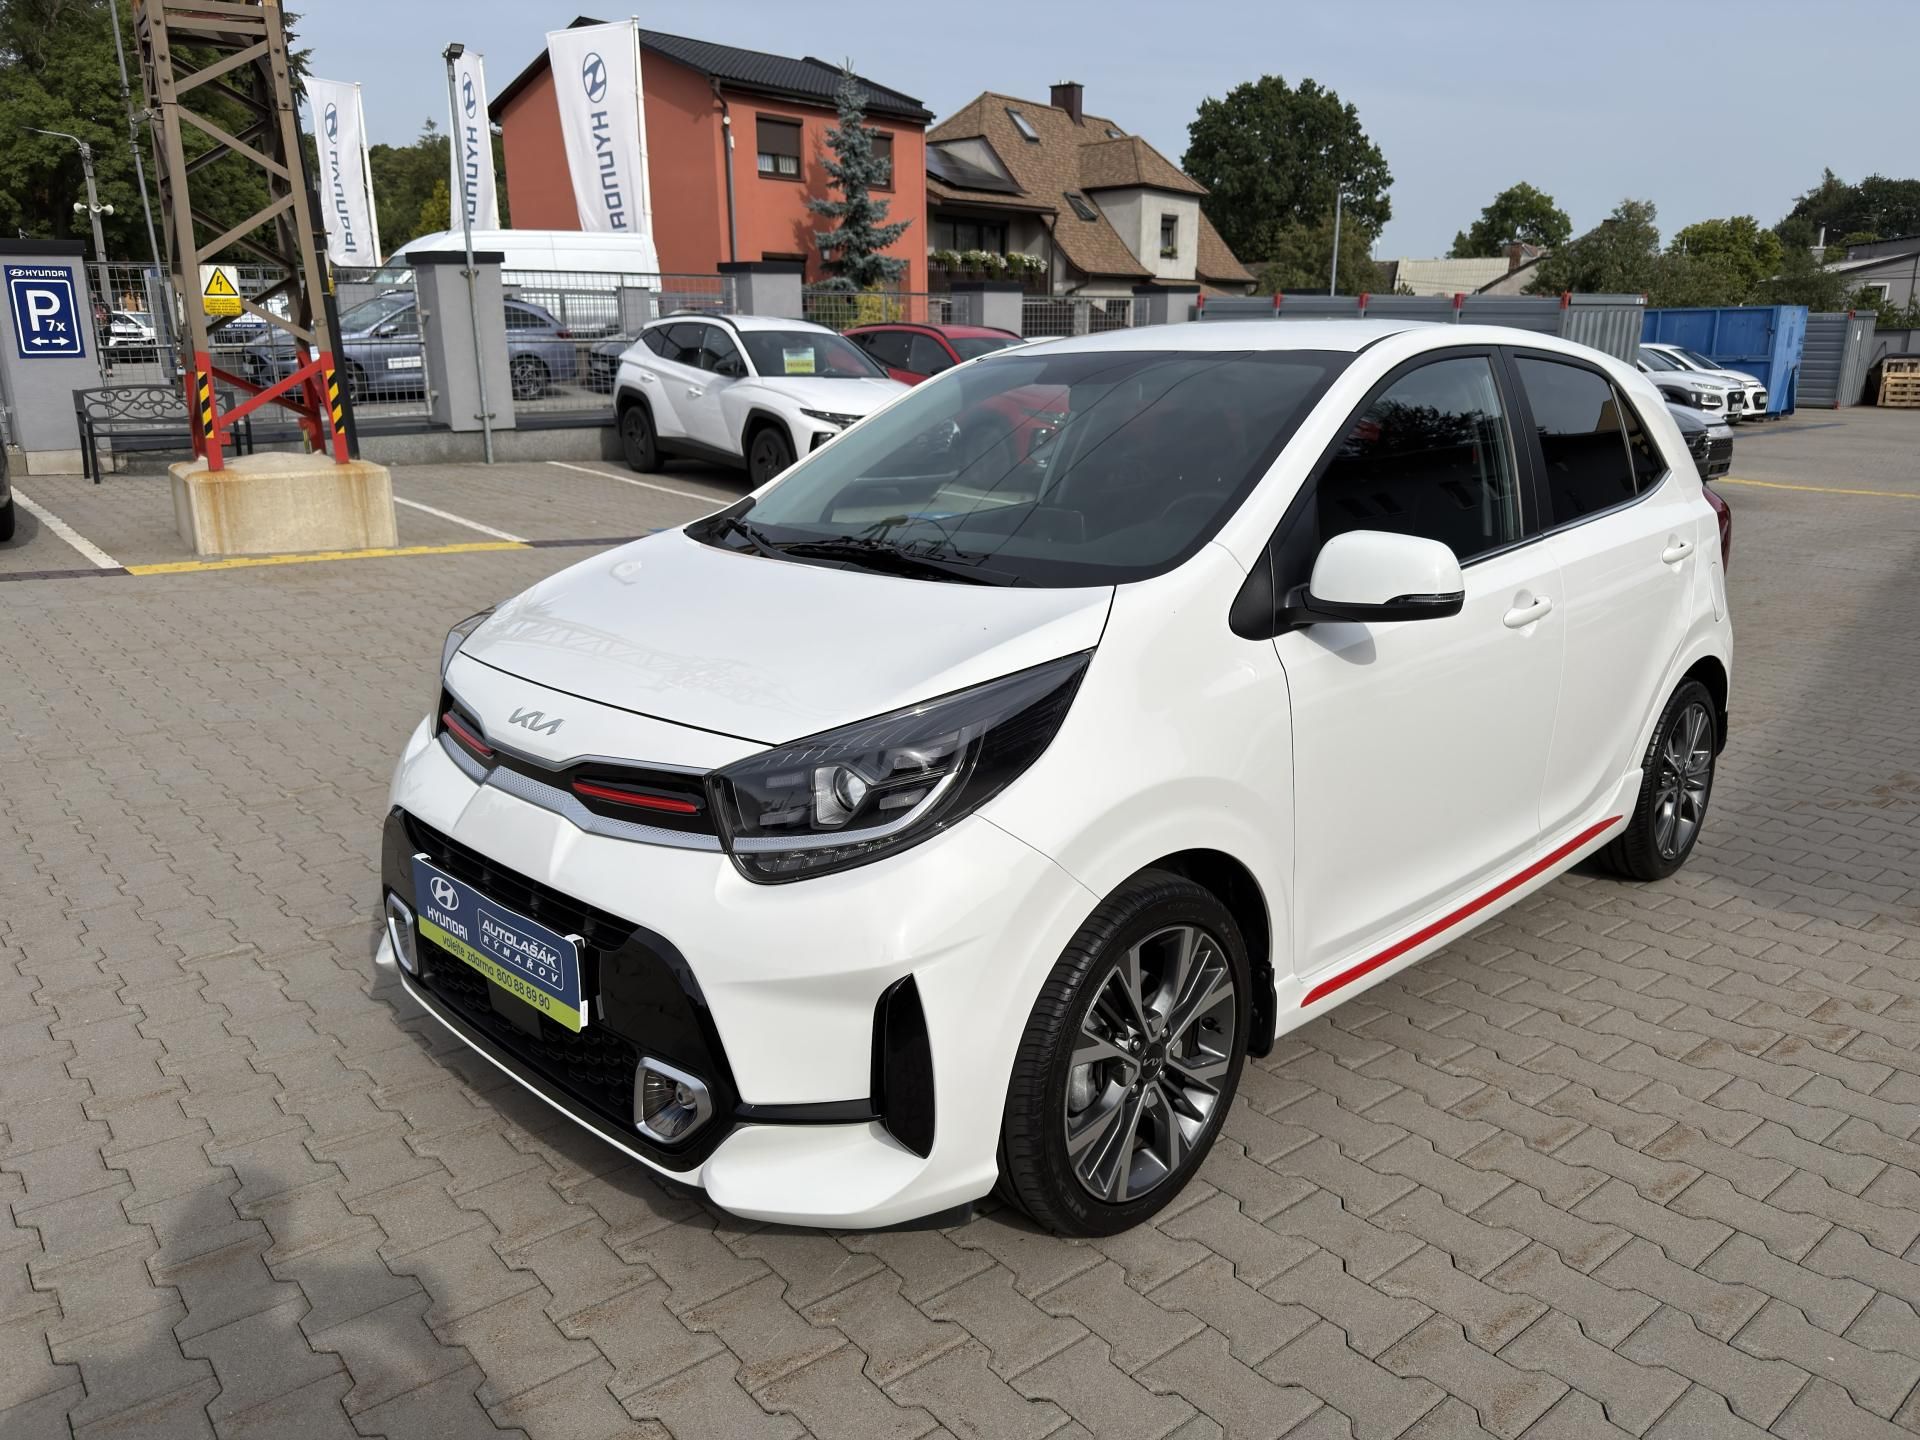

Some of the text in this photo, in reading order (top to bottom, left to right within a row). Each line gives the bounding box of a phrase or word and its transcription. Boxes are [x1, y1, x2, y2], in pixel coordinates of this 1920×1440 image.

[25, 269, 67, 277] HYUNDAI
[26, 290, 60, 331] P
[46, 319, 67, 331] 7x
[427, 905, 468, 941] HYUNDAI
[482, 919, 557, 969] AUTOLAŠÁK
[442, 935, 550, 1011] volejte zdarma 800 88 89 90
